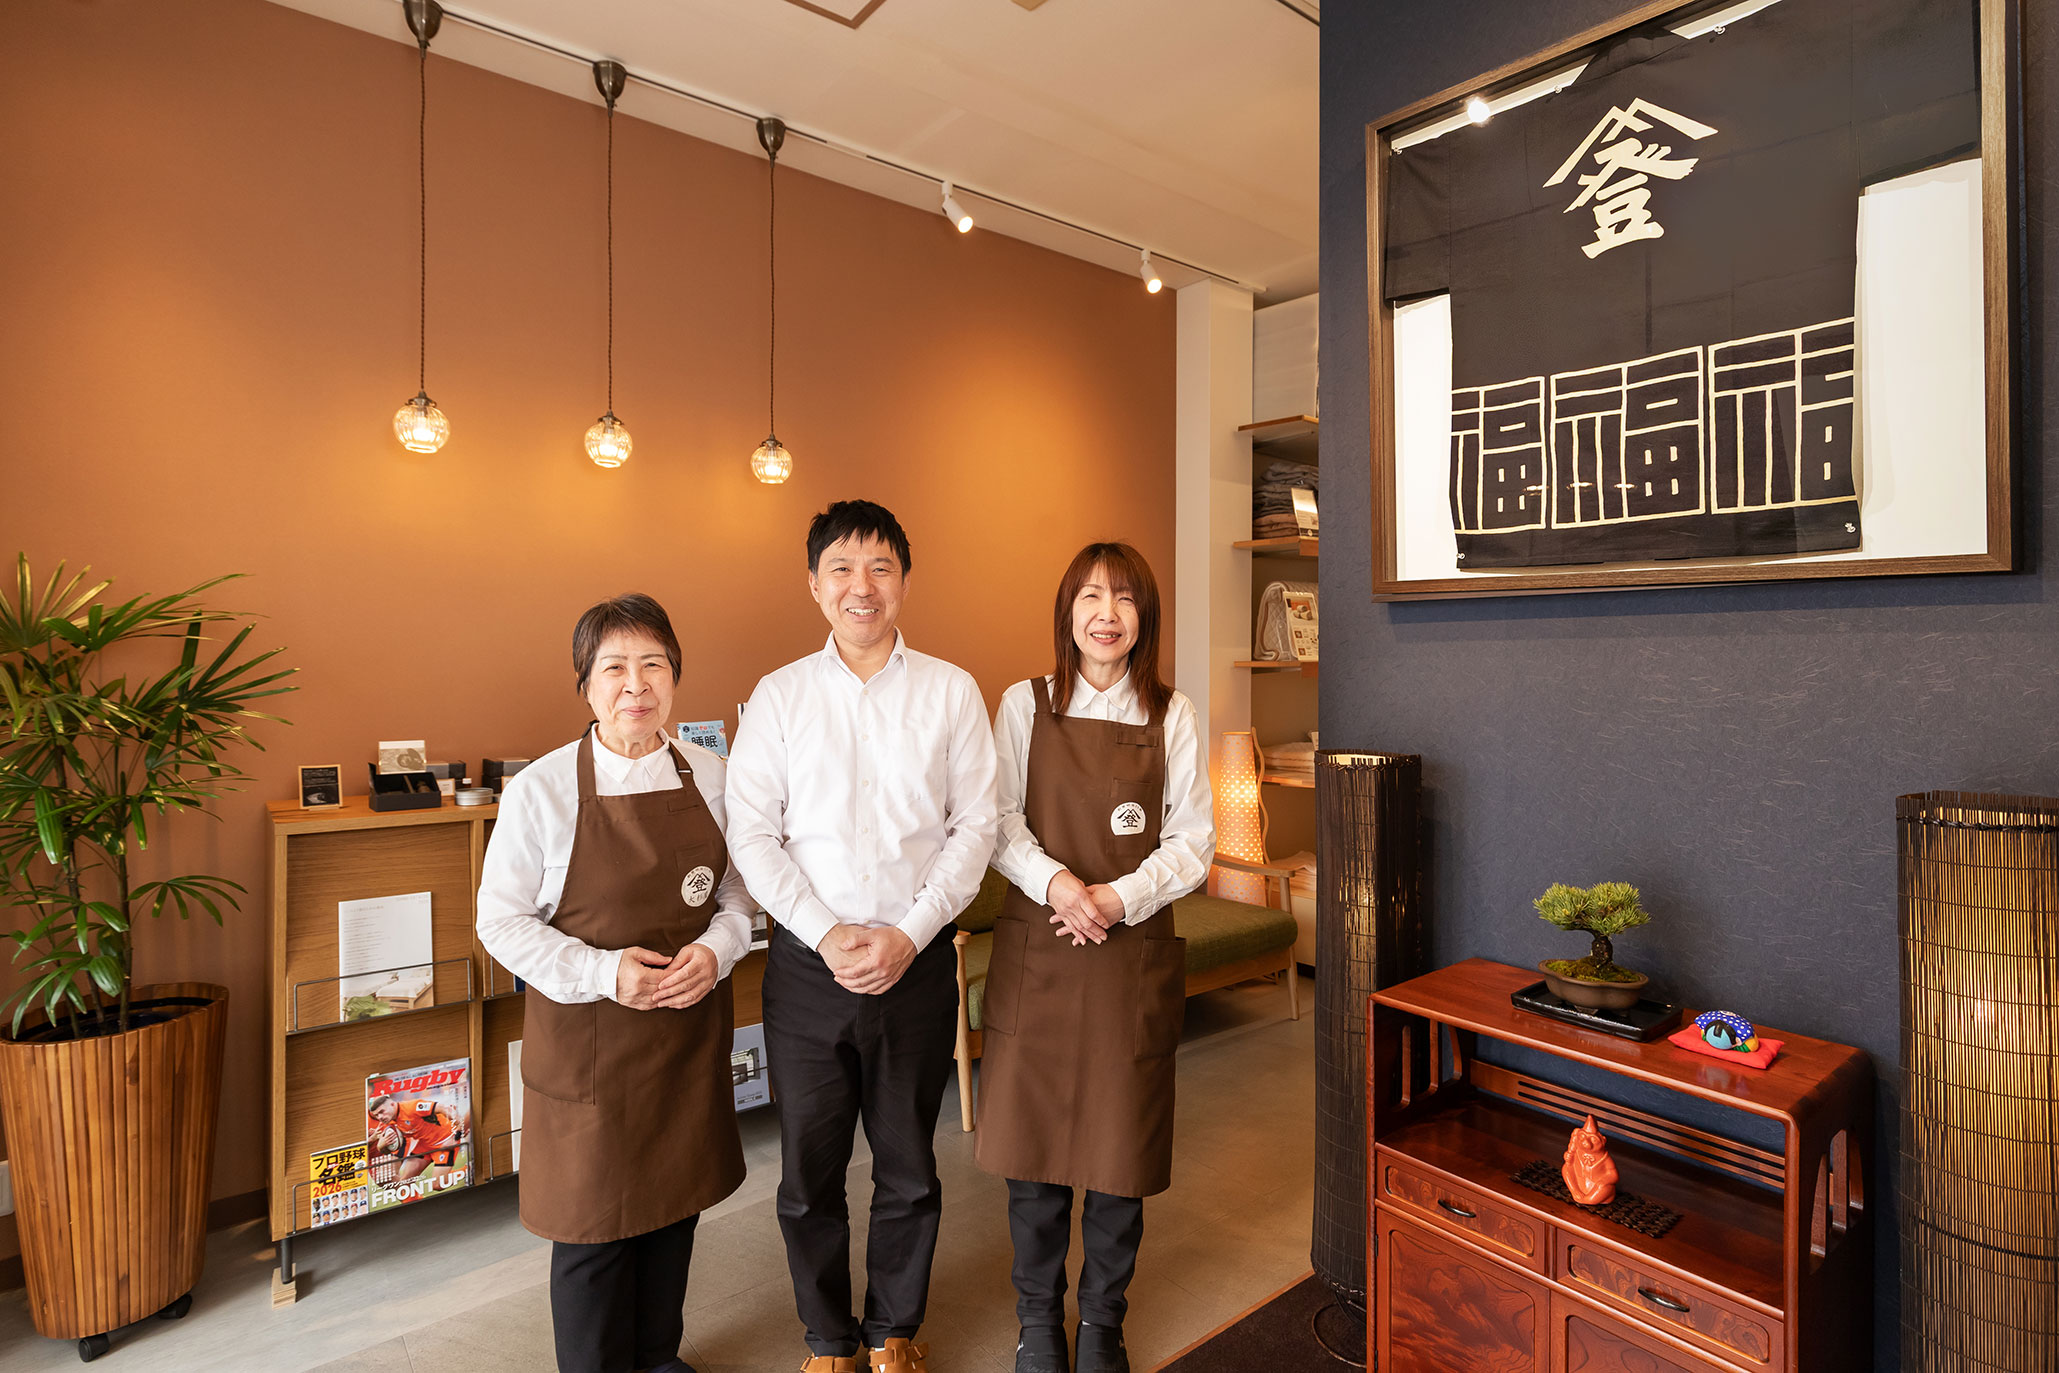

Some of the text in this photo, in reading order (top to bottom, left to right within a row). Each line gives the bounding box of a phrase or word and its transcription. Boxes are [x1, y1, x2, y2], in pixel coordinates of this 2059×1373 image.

[691, 735, 718, 748] 睡眠
[369, 1068, 466, 1097] Rugby
[313, 1181, 342, 1198] 2026
[371, 1177, 437, 1208] FRONT
